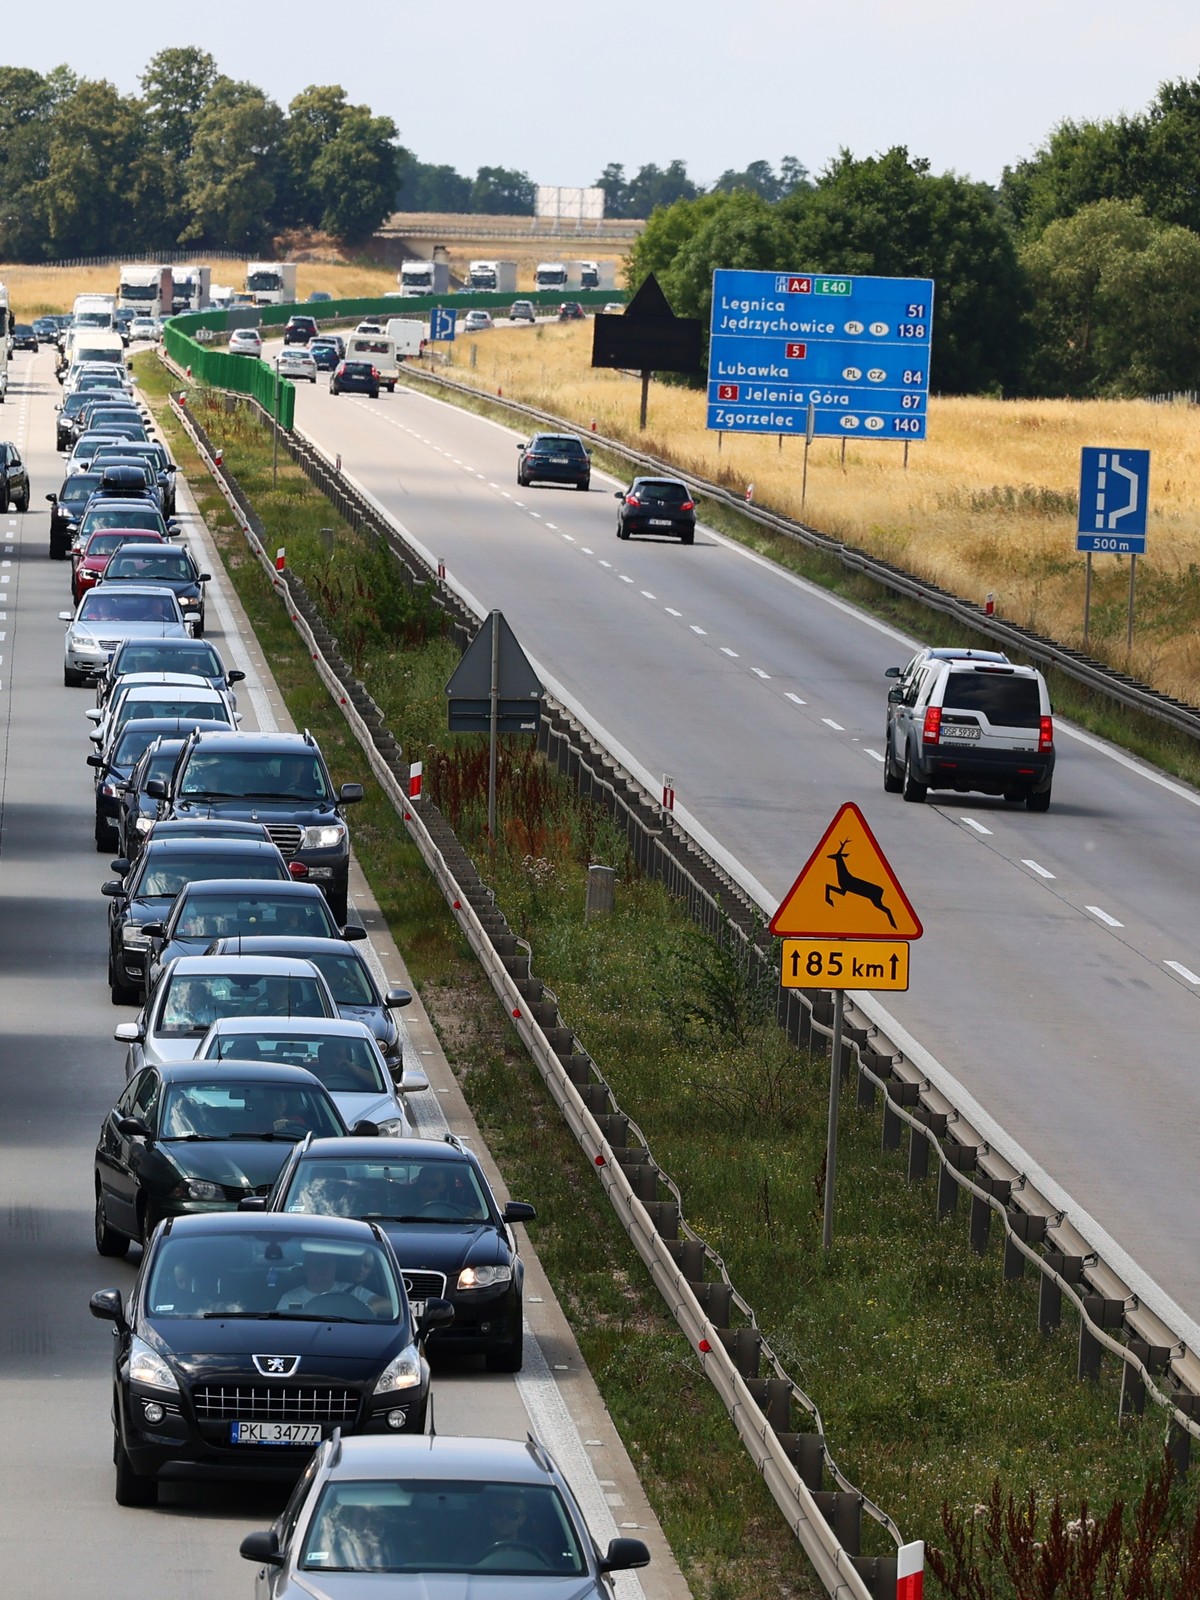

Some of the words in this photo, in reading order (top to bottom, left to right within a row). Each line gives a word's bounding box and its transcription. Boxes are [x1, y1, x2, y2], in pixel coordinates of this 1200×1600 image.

[791, 280, 808, 292] A4
[822, 281, 846, 293] E40
[722, 296, 785, 314] Legnica
[908, 304, 923, 318] 51
[720, 315, 835, 334] Jędrzychowice
[848, 323, 859, 333] PL
[875, 325, 882, 334] D
[898, 324, 925, 338] 138
[792, 345, 800, 357] 5
[718, 361, 789, 378] Lubawka
[846, 369, 857, 378] PL
[869, 371, 883, 380] CZ
[903, 370, 922, 384] 84
[724, 387, 732, 398] 3
[745, 387, 803, 403] Jelenia
[809, 389, 849, 405] Góra
[902, 395, 920, 409] 87
[715, 409, 793, 427] Zgorzelec
[844, 418, 855, 427] PL
[870, 419, 878, 428] D
[894, 418, 920, 432] 140
[1093, 538, 1117, 550] 500
[1119, 542, 1129, 550] m
[806, 951, 843, 976] 85
[852, 957, 884, 977] km
[240, 1424, 268, 1440] PKL
[274, 1425, 320, 1441] 34777
